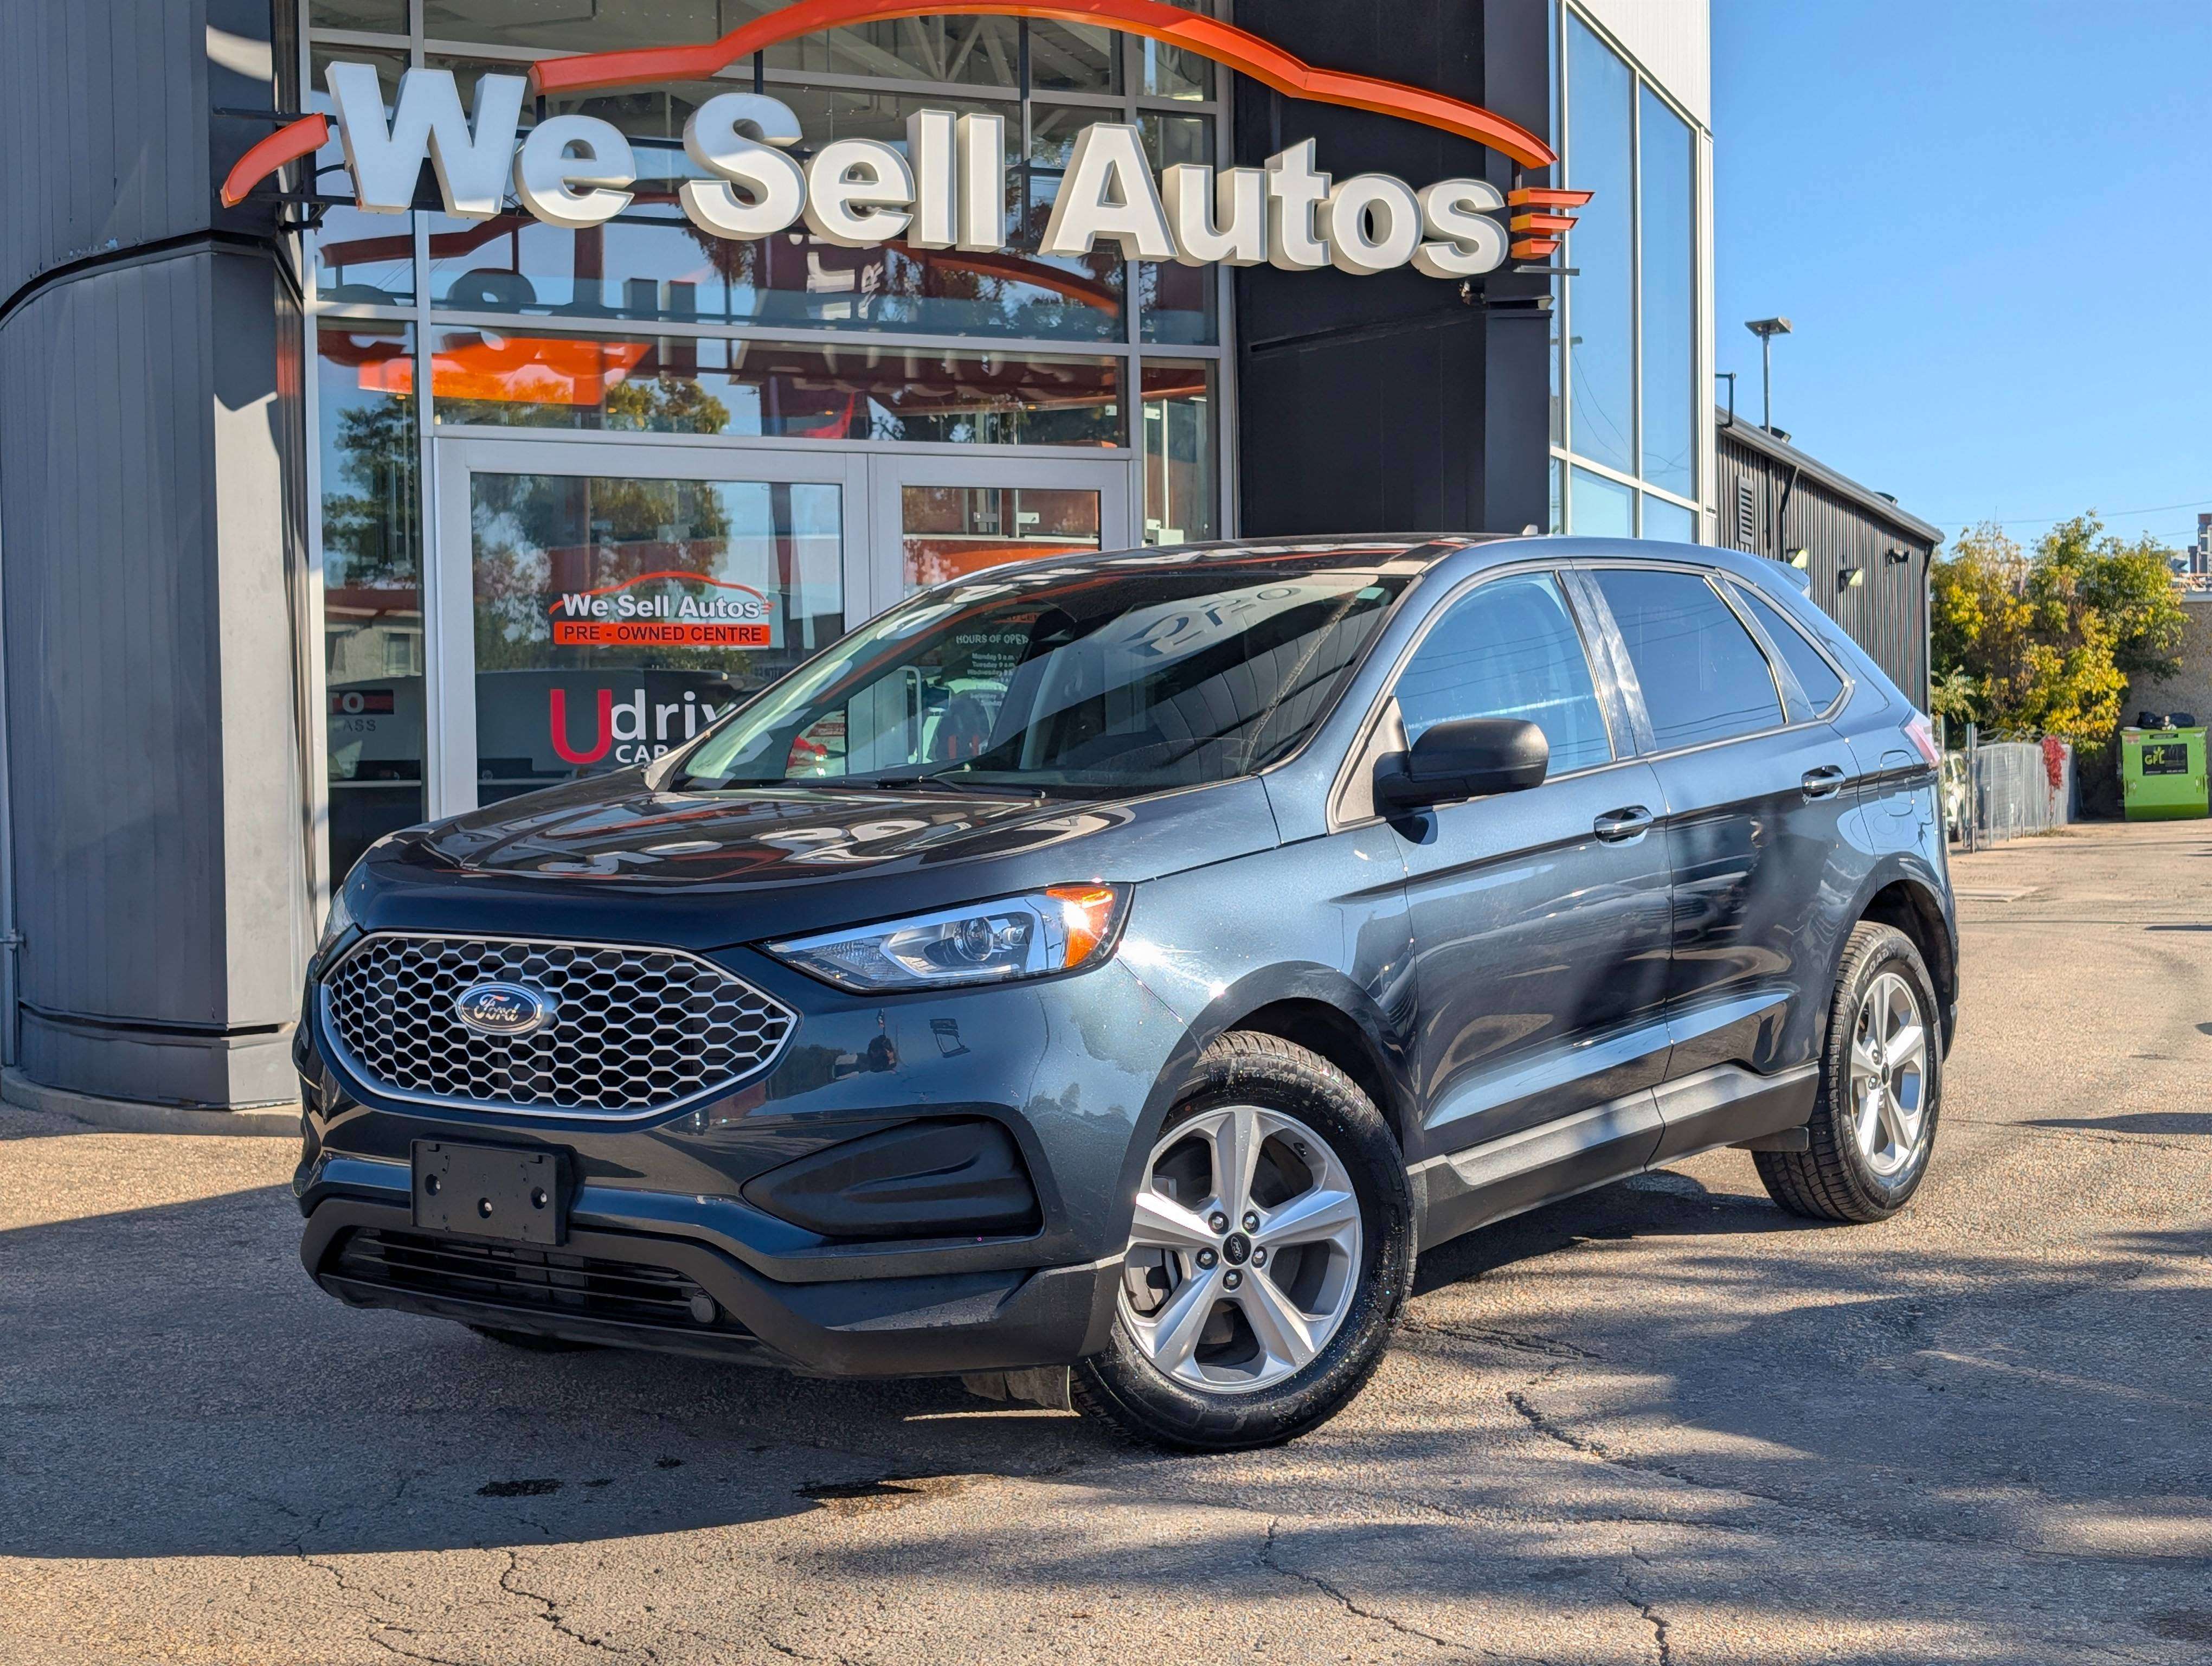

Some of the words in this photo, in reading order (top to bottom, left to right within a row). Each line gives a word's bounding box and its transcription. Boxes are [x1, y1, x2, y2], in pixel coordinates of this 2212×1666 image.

[325, 61, 636, 228] We
[679, 93, 1005, 252] Sell
[1038, 123, 1509, 279] Autos
[562, 593, 609, 617] We
[618, 594, 669, 617] Sell
[679, 595, 760, 618] Autos
[564, 626, 600, 640] PRE
[617, 626, 685, 640] OWNED
[690, 626, 762, 642] CENTRE
[956, 634, 987, 644] HOURS
[989, 634, 1002, 643] OF
[474, 993, 521, 1022] Ford
